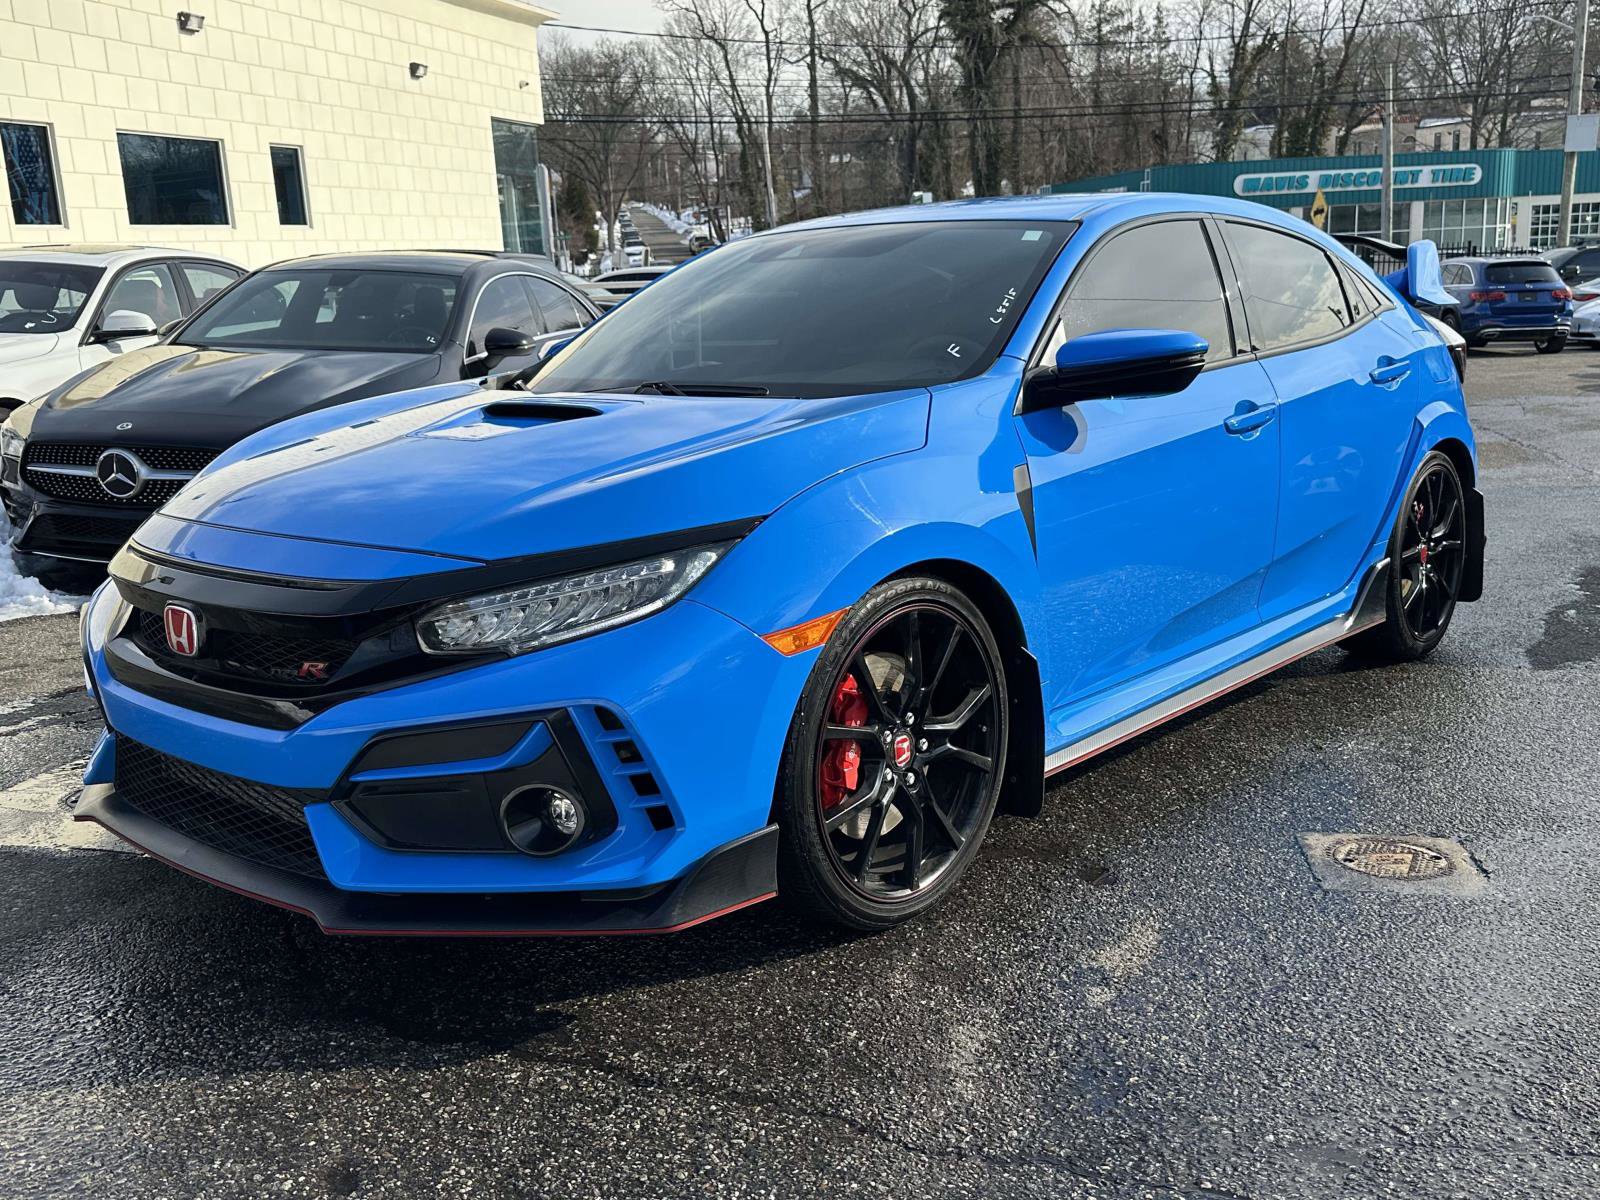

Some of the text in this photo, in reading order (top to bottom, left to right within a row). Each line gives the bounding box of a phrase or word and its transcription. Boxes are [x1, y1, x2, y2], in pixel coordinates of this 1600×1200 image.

[1241, 166, 1477, 194] MAVIS DISCONT TIRE
